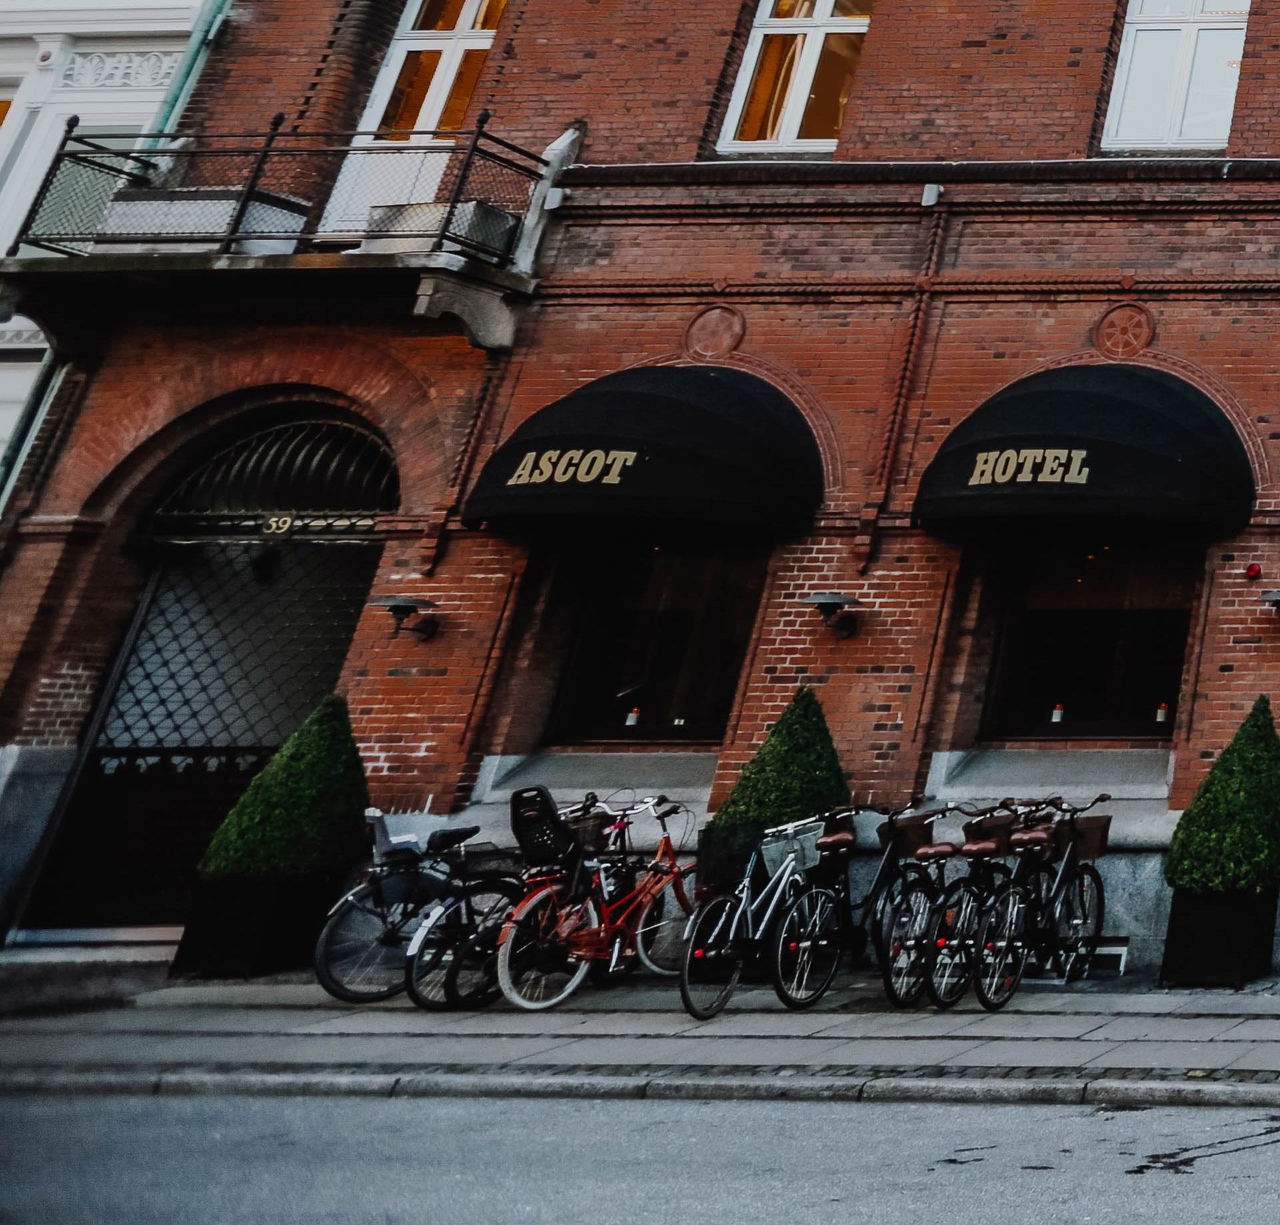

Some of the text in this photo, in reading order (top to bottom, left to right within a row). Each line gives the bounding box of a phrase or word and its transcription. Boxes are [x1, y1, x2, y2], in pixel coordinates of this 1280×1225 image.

[506, 449, 638, 486] ASCOT
[967, 448, 1090, 486] HOTEL
[263, 517, 292, 533] 59
